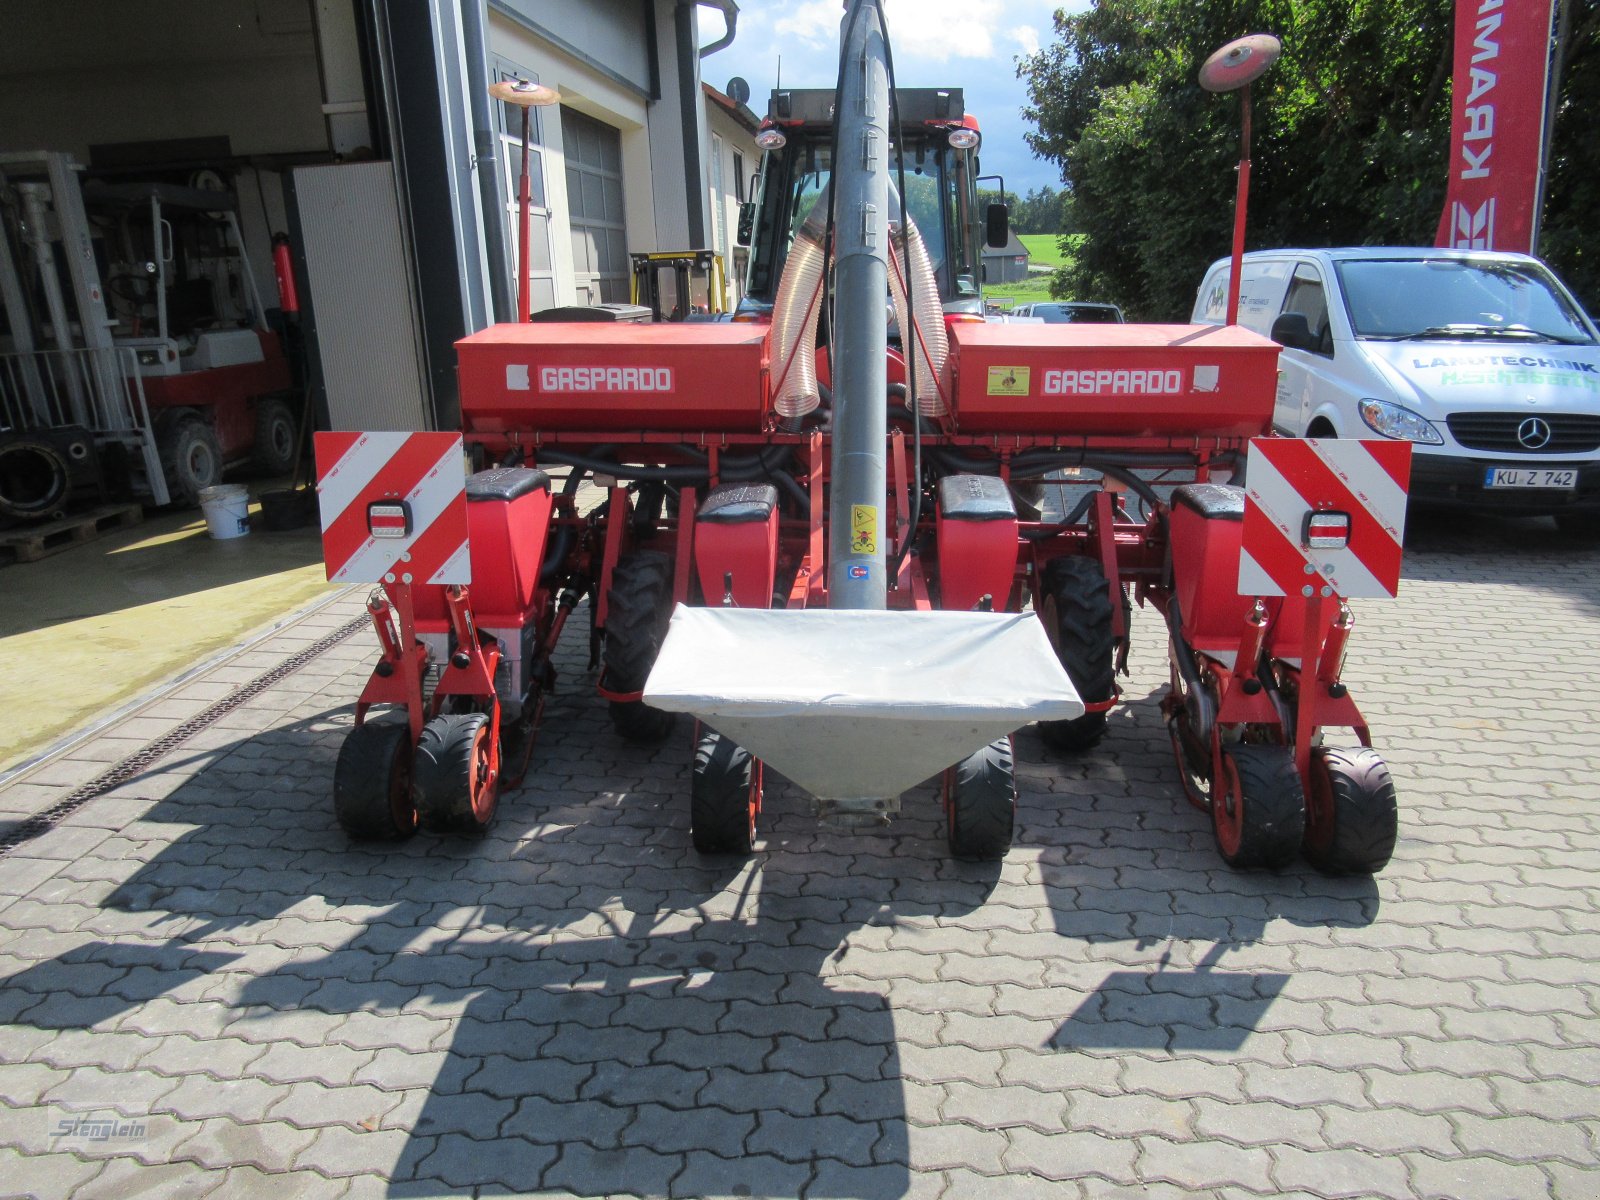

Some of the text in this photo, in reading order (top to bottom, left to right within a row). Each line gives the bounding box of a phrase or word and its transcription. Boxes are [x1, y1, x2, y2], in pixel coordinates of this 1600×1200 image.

[541, 367, 672, 391] GASPARDO
[1044, 370, 1181, 394] GASPARDO
[1496, 471, 1573, 486] KU Z 742
